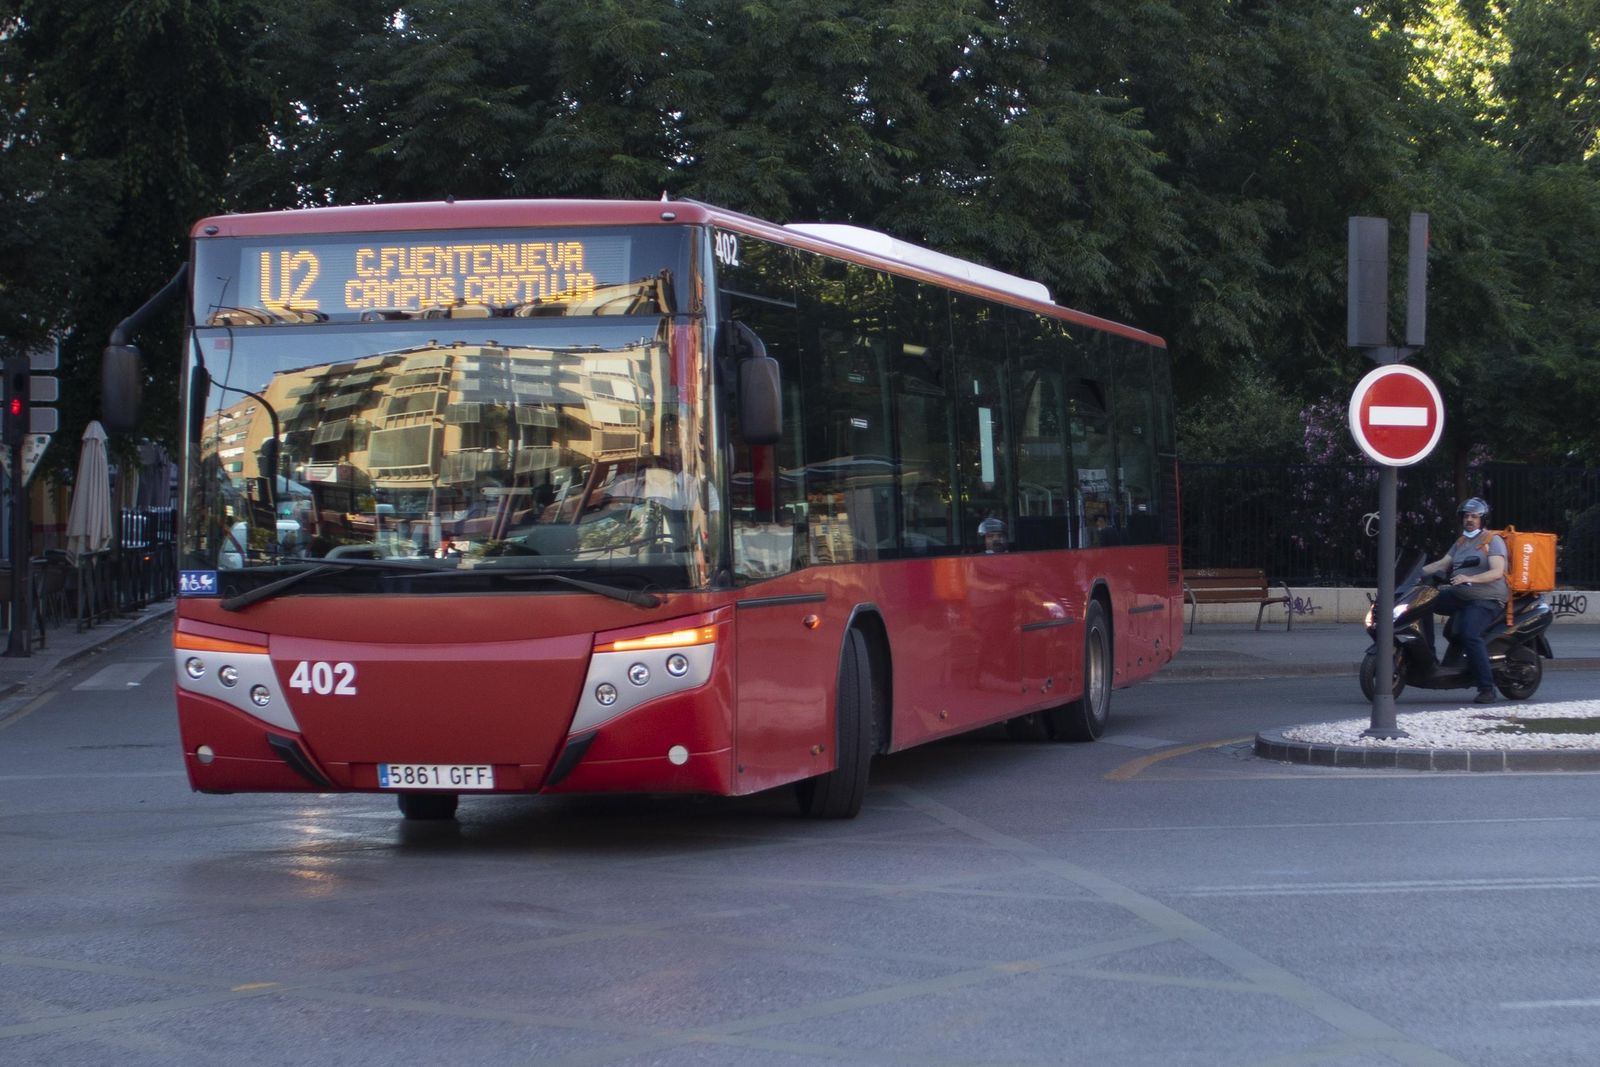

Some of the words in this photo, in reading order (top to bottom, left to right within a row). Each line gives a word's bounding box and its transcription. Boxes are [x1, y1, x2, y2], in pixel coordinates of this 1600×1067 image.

[356, 242, 583, 277] C.FUENTENUEVA
[714, 230, 739, 267] 402
[260, 250, 319, 309] U2
[345, 277, 455, 308] CAMPUS
[464, 272, 596, 305] CARTUJA
[289, 661, 357, 696] 402
[390, 767, 440, 785] 5861
[450, 767, 488, 785] GFF
